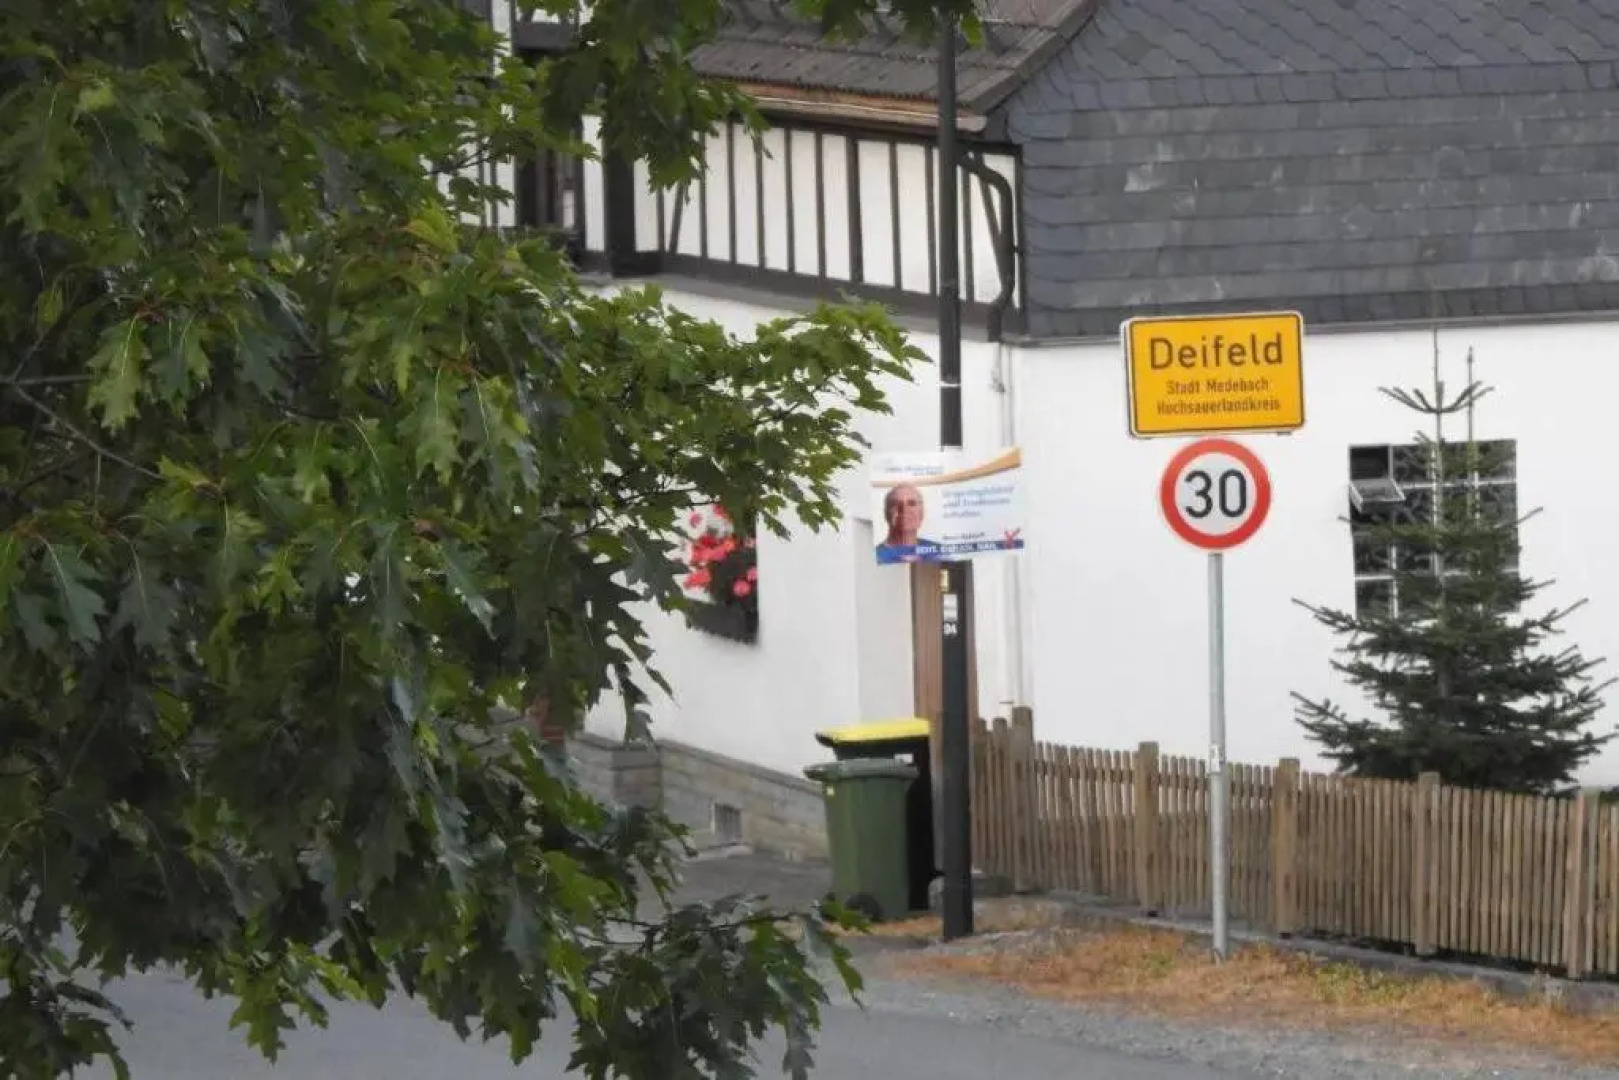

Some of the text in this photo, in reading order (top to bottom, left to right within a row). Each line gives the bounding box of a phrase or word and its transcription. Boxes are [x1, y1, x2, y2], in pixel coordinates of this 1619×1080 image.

[1150, 333, 1283, 370] Deifeld
[1166, 377, 1269, 395] Stadt Medebach
[1156, 397, 1280, 415] Hochsauerlandkreis
[1185, 469, 1247, 518] 30
